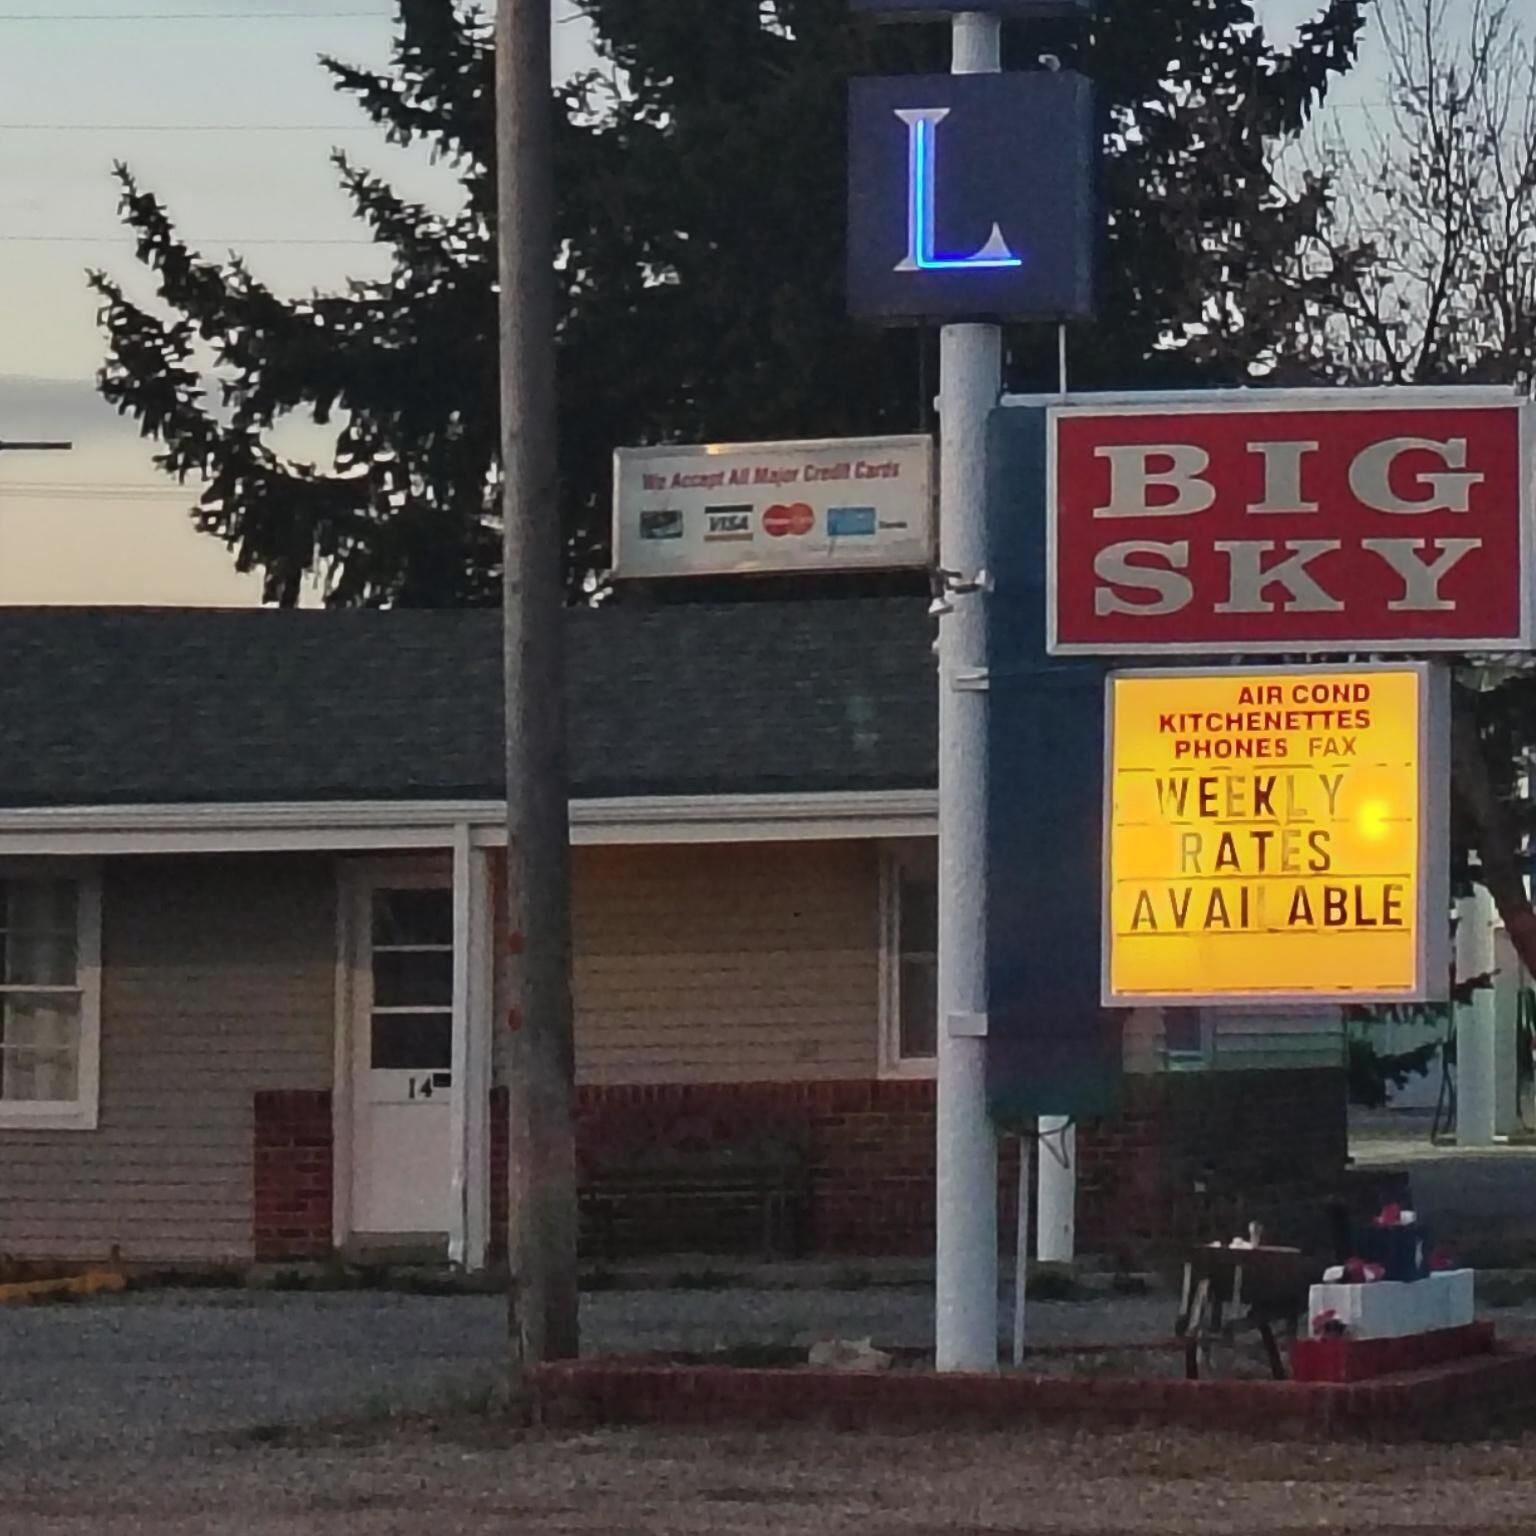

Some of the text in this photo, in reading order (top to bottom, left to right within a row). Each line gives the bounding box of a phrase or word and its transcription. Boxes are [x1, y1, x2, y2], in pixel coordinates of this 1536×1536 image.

[642, 461, 899, 490] We Accept All Major Credit Cards
[1093, 437, 1484, 518] BIG
[709, 515, 749, 532] VISA
[1093, 538, 1482, 616] SKY
[1238, 683, 1370, 705] AIR COND
[1159, 709, 1370, 734] KITCHENETTES
[1175, 737, 1357, 759] PHONES FAX
[1156, 774, 1344, 817] WEEKLY
[1181, 830, 1331, 873] RATES
[408, 1077, 433, 1099] 14
